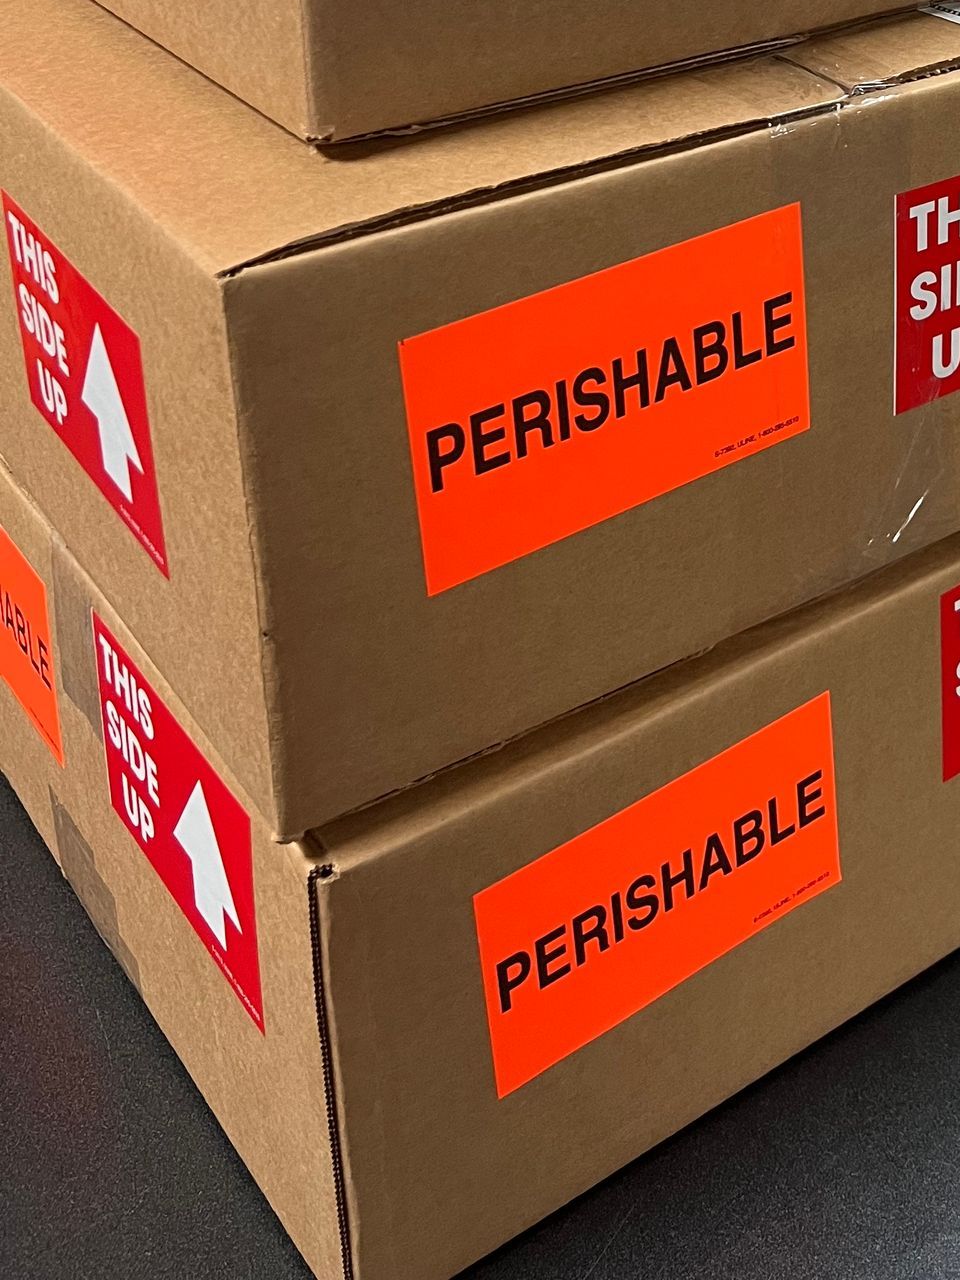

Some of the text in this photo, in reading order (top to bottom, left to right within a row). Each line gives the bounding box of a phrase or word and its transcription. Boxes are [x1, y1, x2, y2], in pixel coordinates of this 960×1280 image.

[8, 210, 60, 304] THIS
[19, 284, 70, 377] SIDE
[37, 359, 68, 425] UP
[426, 291, 795, 493] PERISHABLE
[0, 585, 52, 690] ABLE
[99, 634, 154, 740] THIS
[106, 700, 160, 808] SIDE
[121, 772, 155, 843] UP
[496, 770, 825, 1013] PERISHABLE
